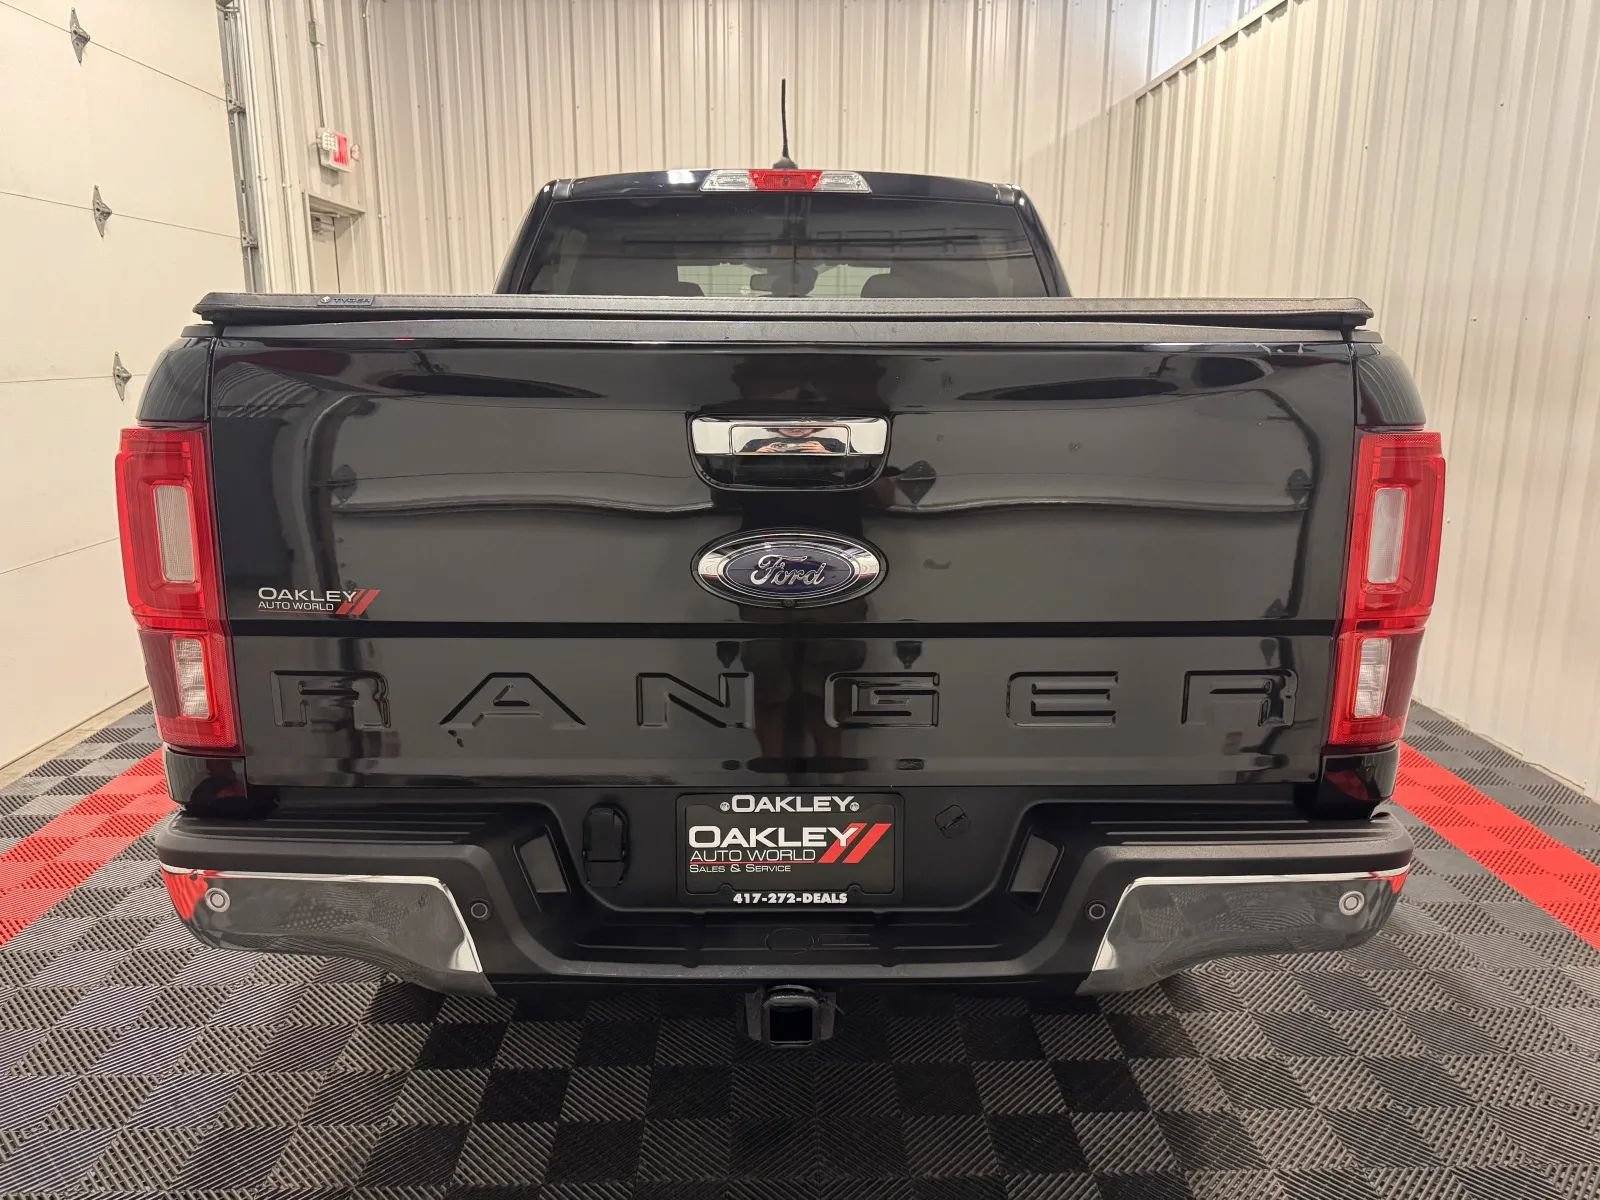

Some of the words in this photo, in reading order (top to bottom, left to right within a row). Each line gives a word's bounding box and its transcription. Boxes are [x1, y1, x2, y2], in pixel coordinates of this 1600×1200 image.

[750, 554, 827, 586] Ford
[258, 587, 357, 603] OAKLEY
[258, 601, 291, 610] AUTO
[292, 602, 334, 611] WORLD
[270, 669, 1299, 729] RANGER
[731, 794, 855, 813] OAKLEY
[688, 825, 860, 848] OAKLEY
[690, 850, 742, 862] AUTO
[746, 850, 816, 862] WORLD
[730, 864, 741, 873] &
[732, 893, 848, 904] 417-272-DEALS
